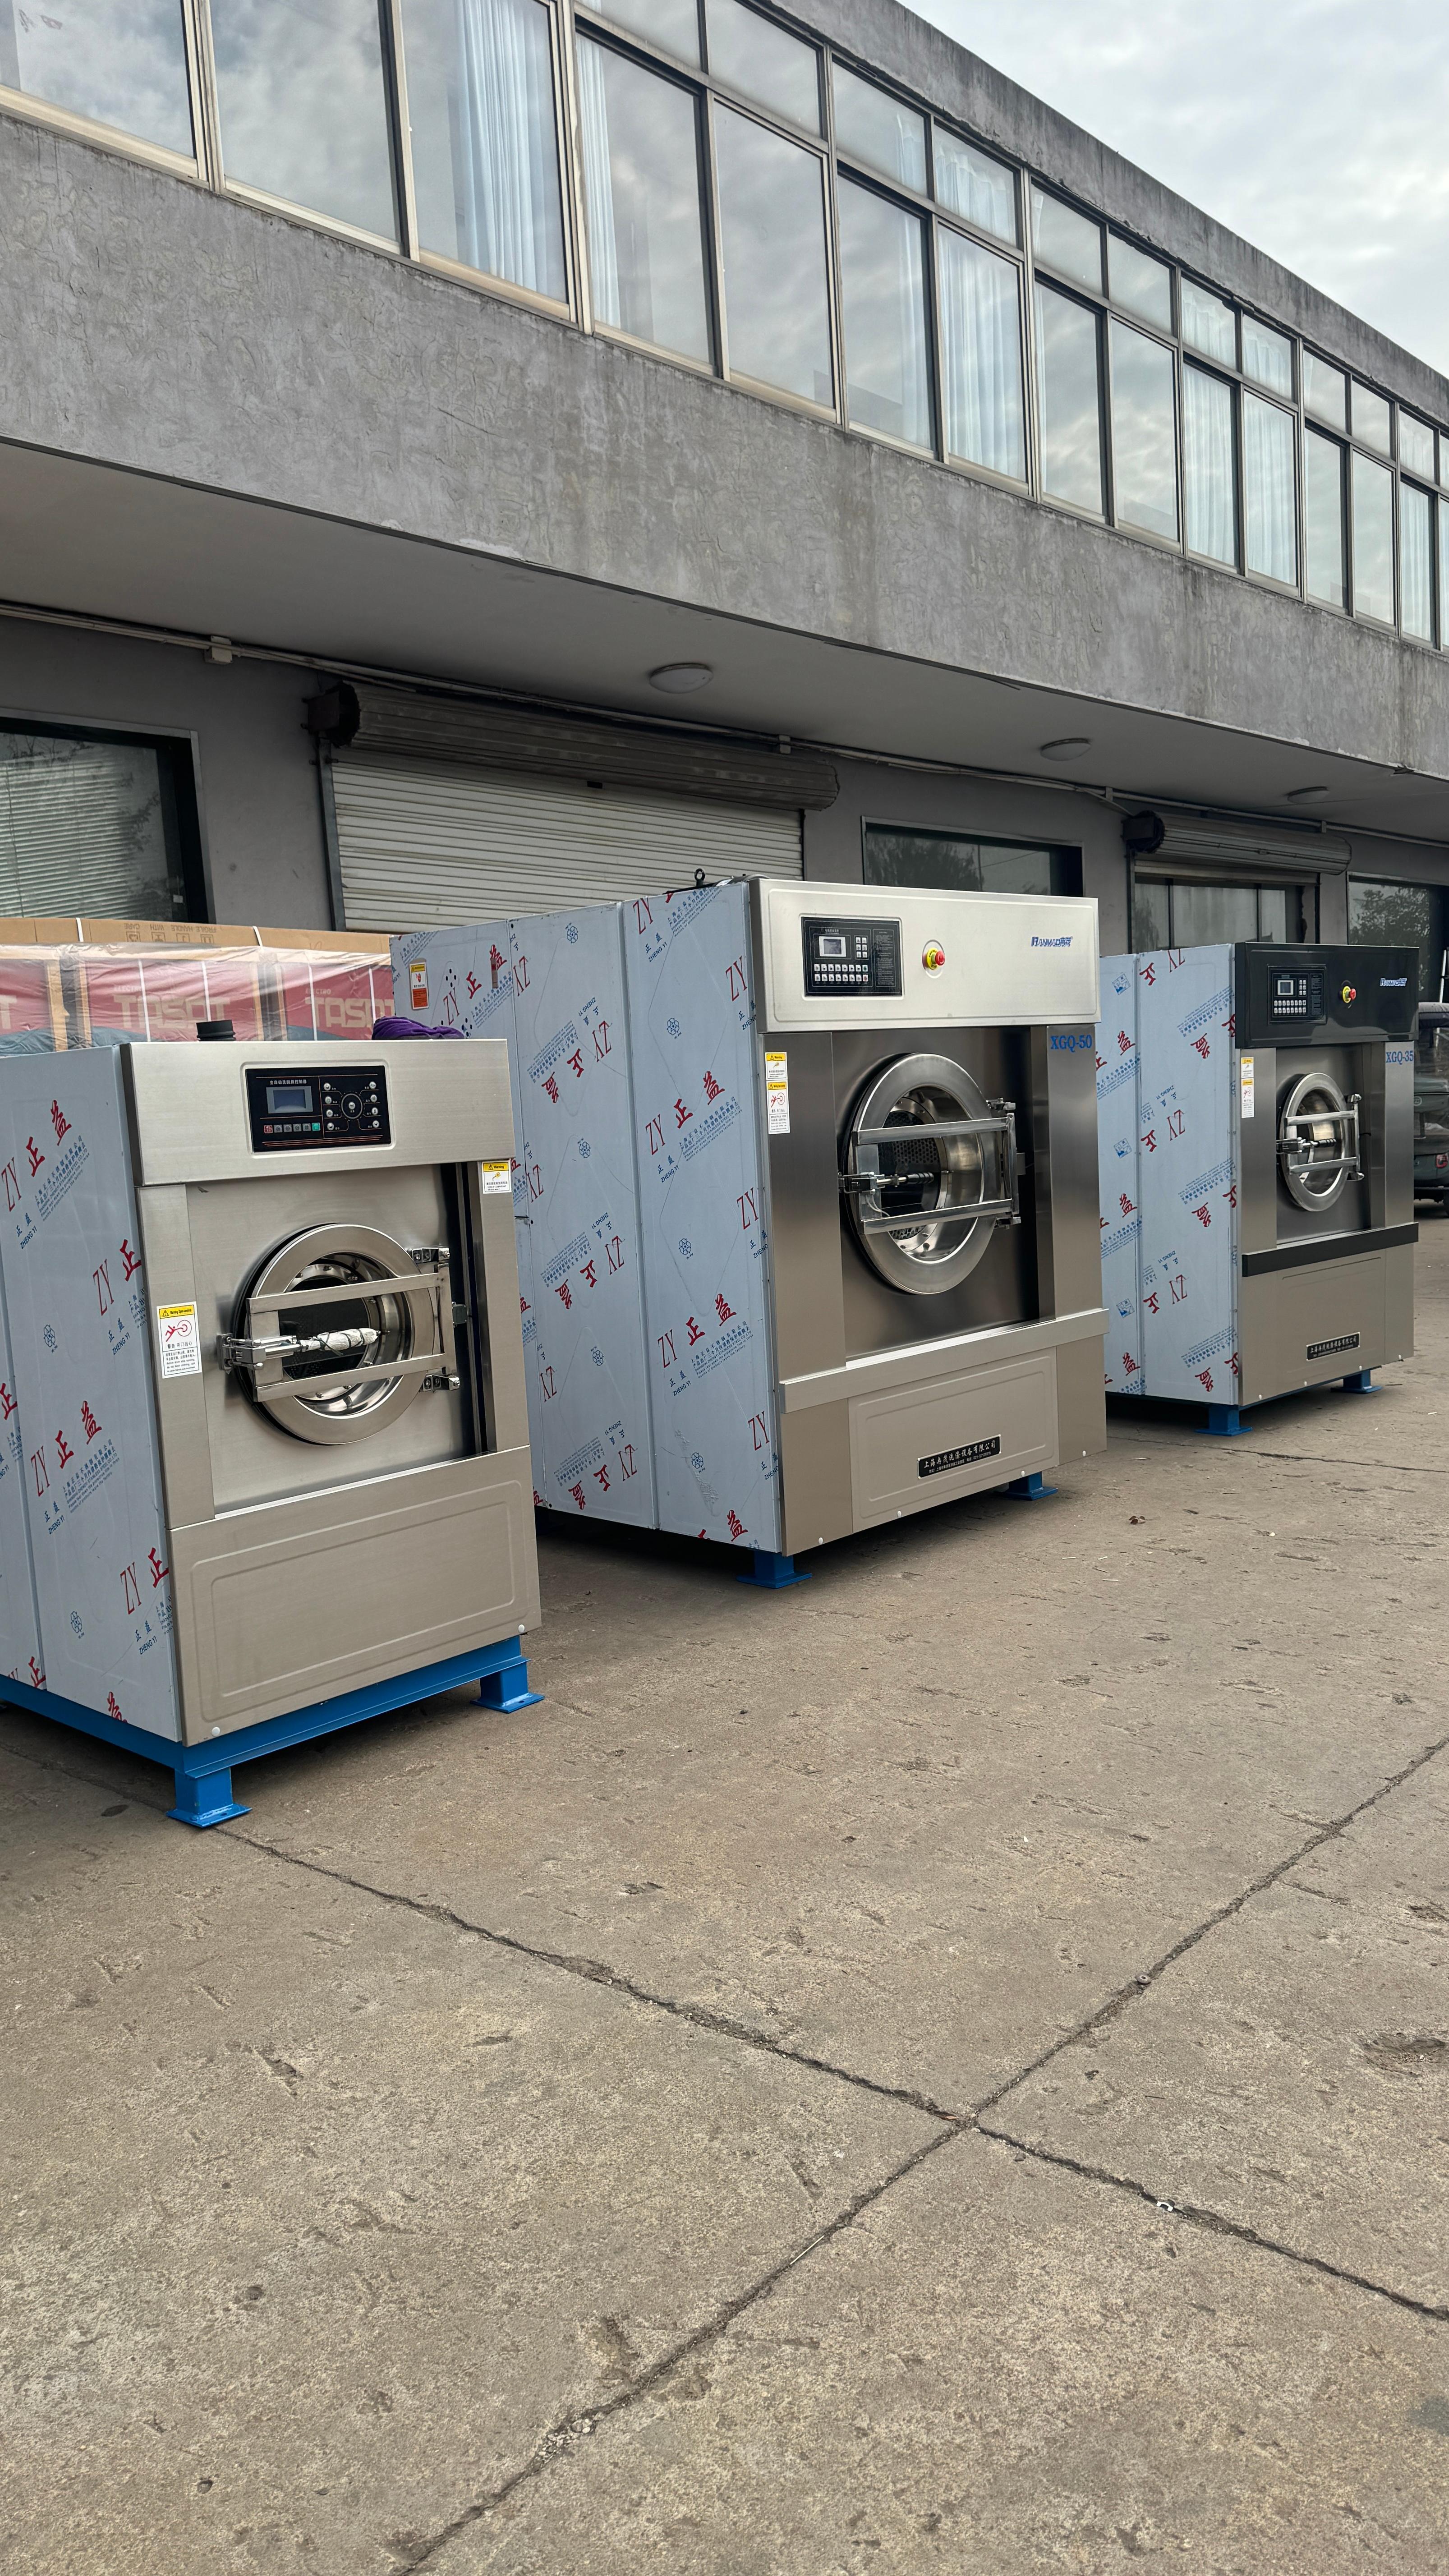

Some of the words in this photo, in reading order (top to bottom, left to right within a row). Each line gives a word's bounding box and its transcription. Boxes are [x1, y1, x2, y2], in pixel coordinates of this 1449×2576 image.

[632, 897, 653, 935] ZY
[648, 947, 662, 962] ZHENG
[513, 956, 530, 997] ZY
[725, 956, 747, 1002] ZY
[443, 987, 460, 1026] ZY
[583, 997, 596, 1012] ZHENG
[592, 1021, 612, 1063] ZY
[1050, 1034, 1093, 1053] XGQ-50
[1385, 1050, 1414, 1065] XGQ-35
[1162, 1085, 1175, 1097] ZHENG
[645, 1114, 666, 1155] ZY
[1166, 1109, 1186, 1141] ZY
[1, 1157, 22, 1212] ZY
[526, 1164, 544, 1203] ZY
[660, 1168, 675, 1183] ZHENG
[596, 1212, 609, 1227] ZHENG
[736, 1187, 759, 1230] ZY
[20, 1231, 33, 1250] ZHENG
[32, 1225, 37, 1233] YI
[753, 1243, 769, 1259] ZHENG
[605, 1235, 625, 1275] ZY
[1163, 1250, 1176, 1261] ZHENG
[92, 1259, 114, 1316] ZY
[1168, 1274, 1188, 1305] ZY
[112, 1337, 126, 1356] ZHENG
[124, 1332, 130, 1340] YI
[657, 1329, 677, 1368] ZY
[540, 1366, 557, 1403] ZY
[672, 1384, 687, 1396] ZHENG
[610, 1420, 621, 1433] ZHENG
[748, 1410, 770, 1451] ZY
[31, 1445, 50, 1497] ZY
[618, 1443, 637, 1481] ZY
[48, 1519, 61, 1535] ZHENG
[120, 1561, 142, 1615] ZY
[139, 1639, 153, 1655] ZHENG
